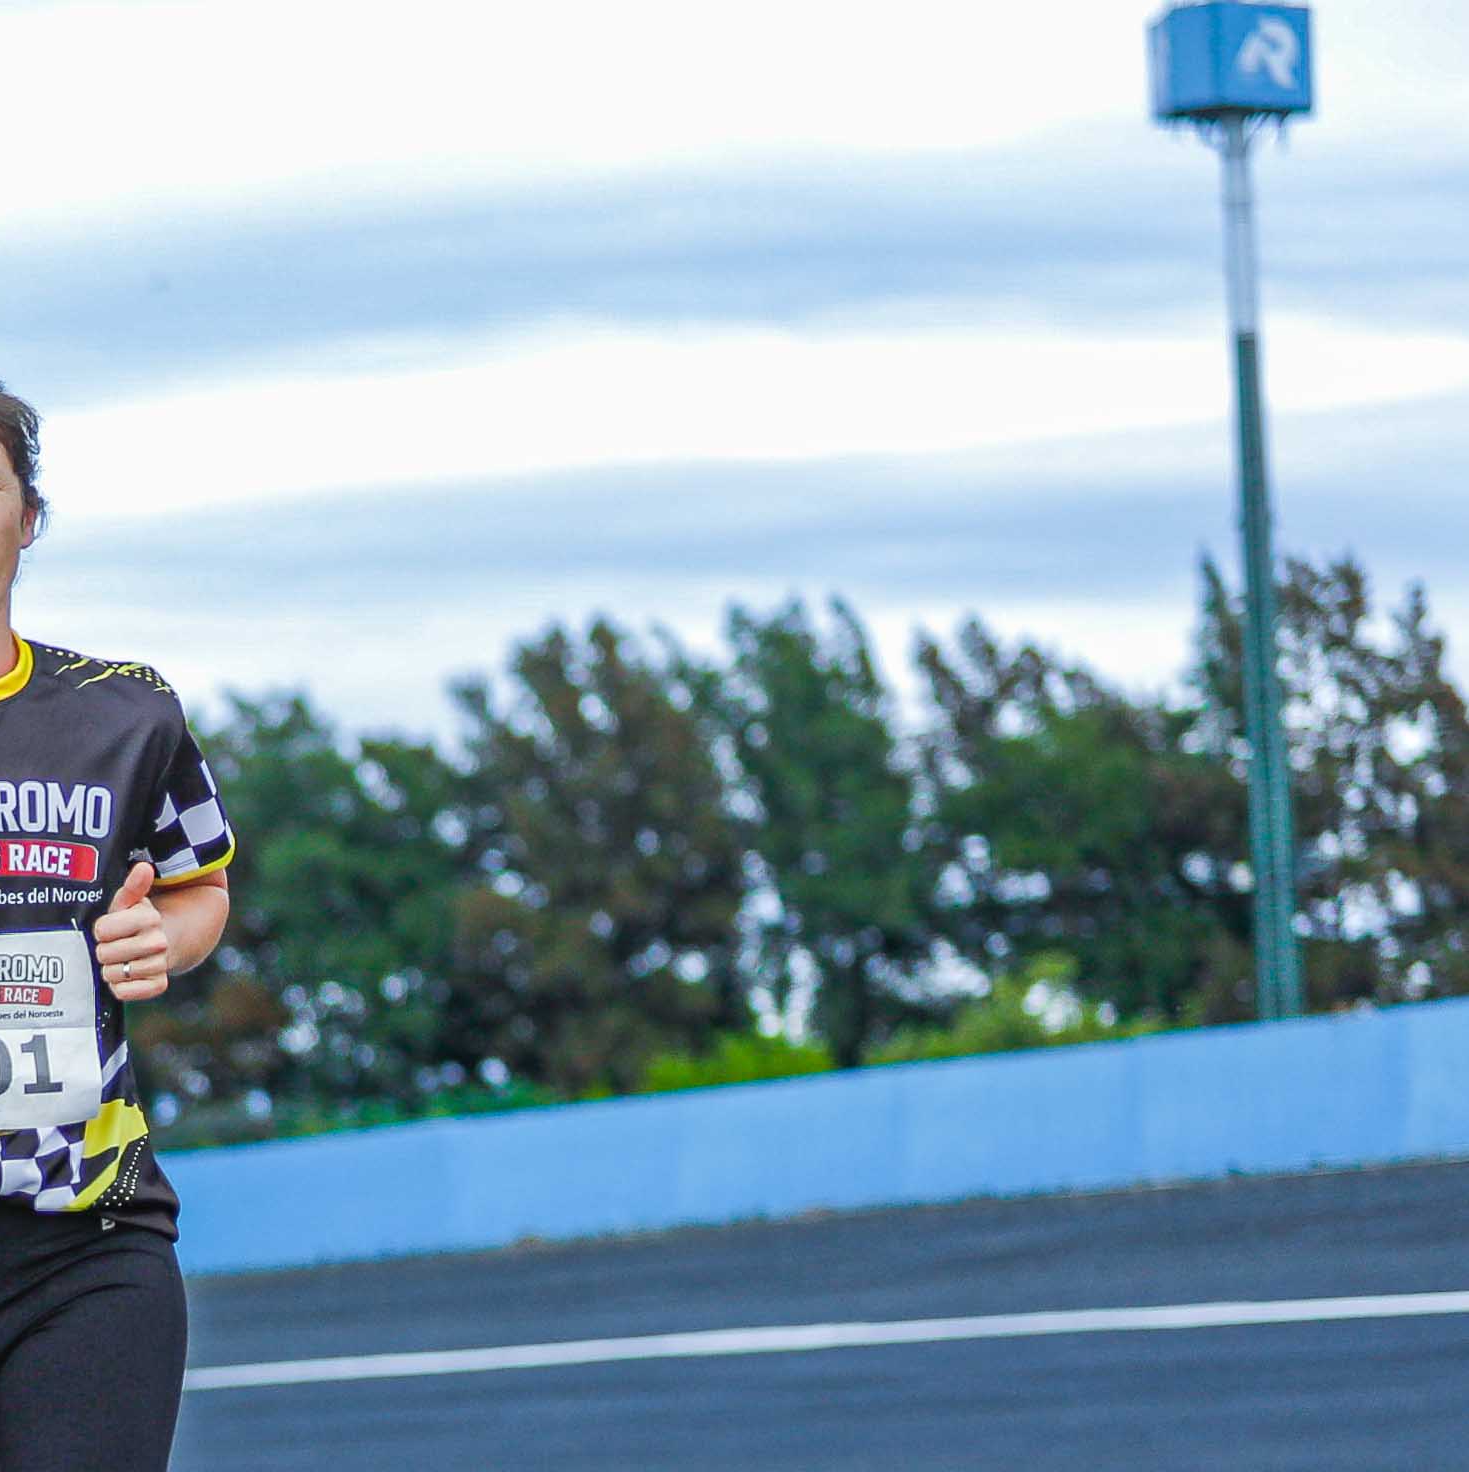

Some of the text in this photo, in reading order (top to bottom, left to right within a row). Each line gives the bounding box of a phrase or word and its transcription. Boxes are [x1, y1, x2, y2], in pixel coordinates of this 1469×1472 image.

[8, 844, 70, 876] RACE
[27, 887, 49, 904] del
[4, 987, 40, 1004] RACE
